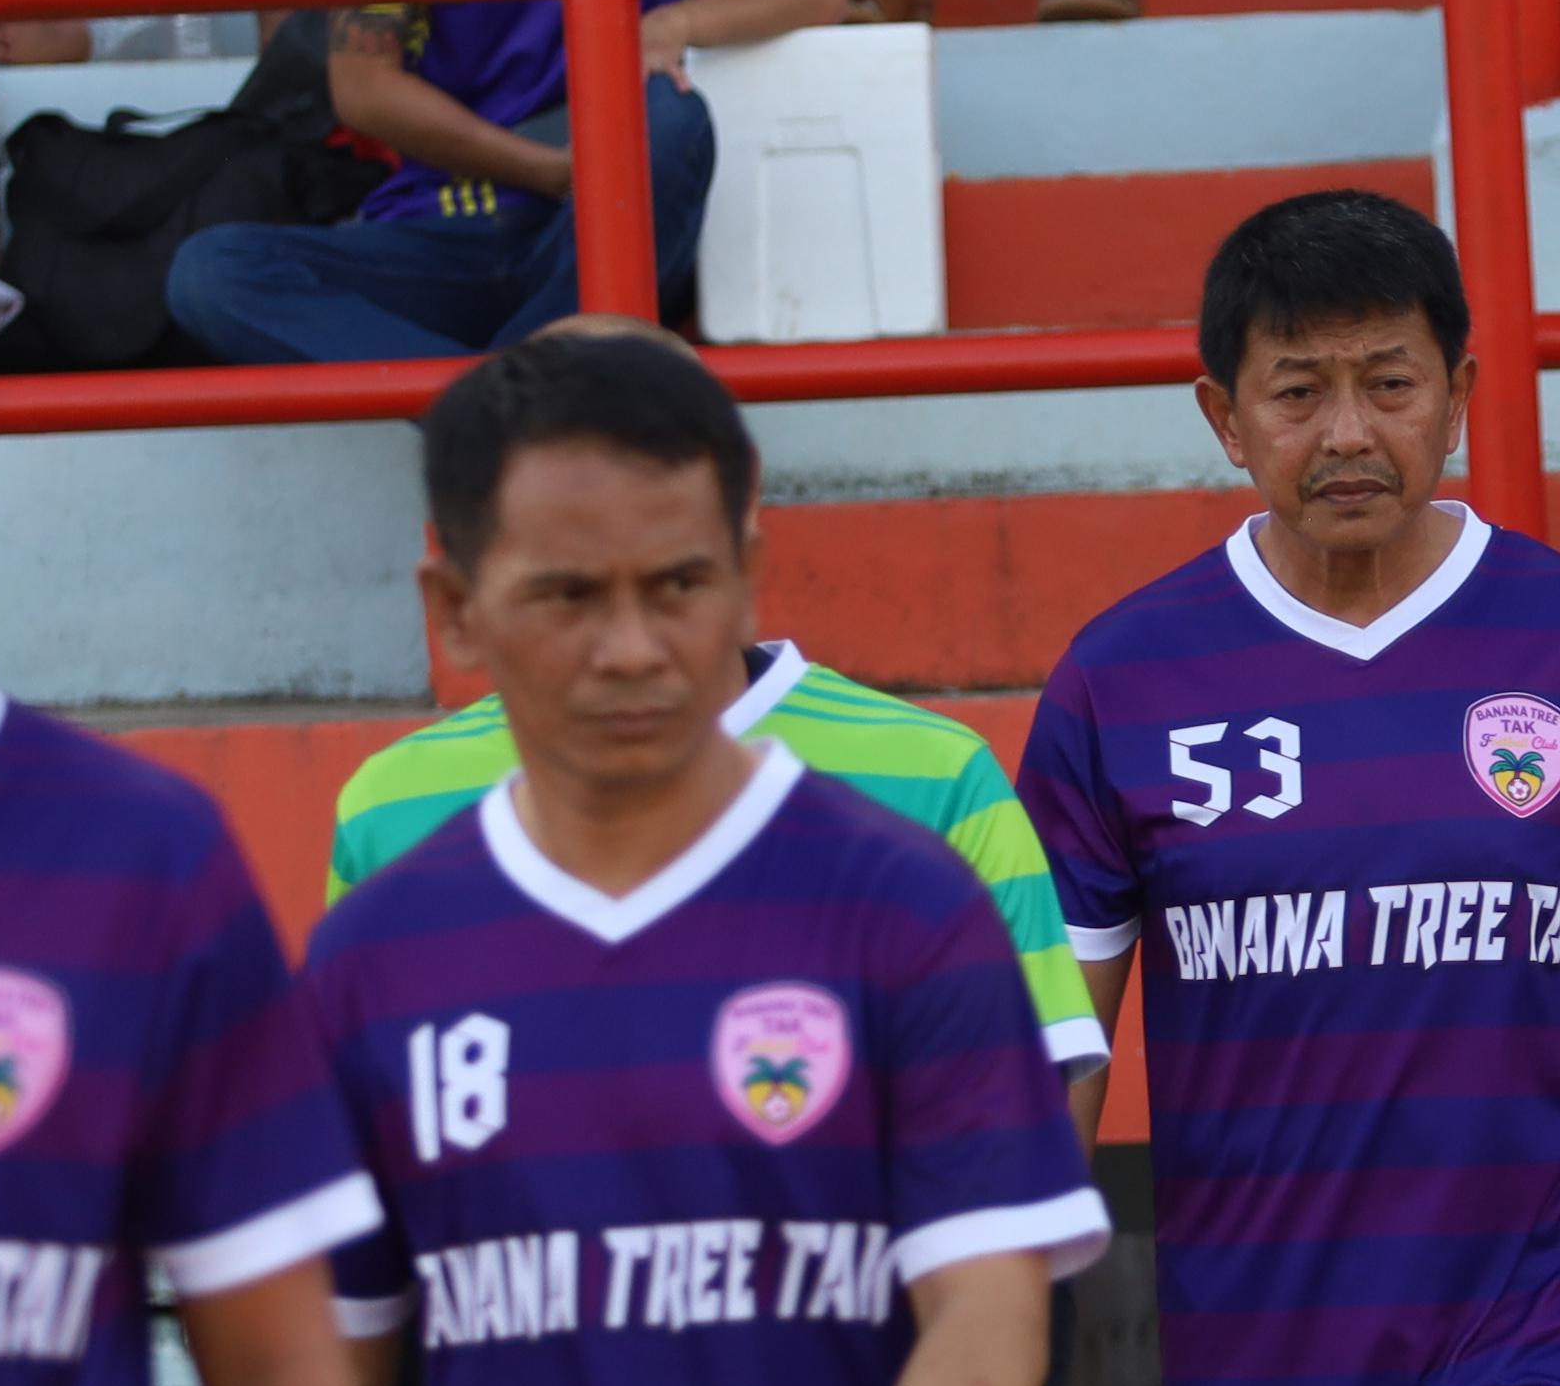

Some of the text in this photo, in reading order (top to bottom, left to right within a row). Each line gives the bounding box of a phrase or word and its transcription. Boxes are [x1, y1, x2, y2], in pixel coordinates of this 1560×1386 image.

[1475, 704, 1560, 726] BANANA TREE
[1501, 719, 1537, 734] TAK
[1168, 716, 1303, 827] 53
[1165, 889, 1346, 982] BANANA
[1367, 880, 1513, 971] TREE
[409, 1012, 510, 1162] 18
[601, 1218, 764, 1333] TREE
